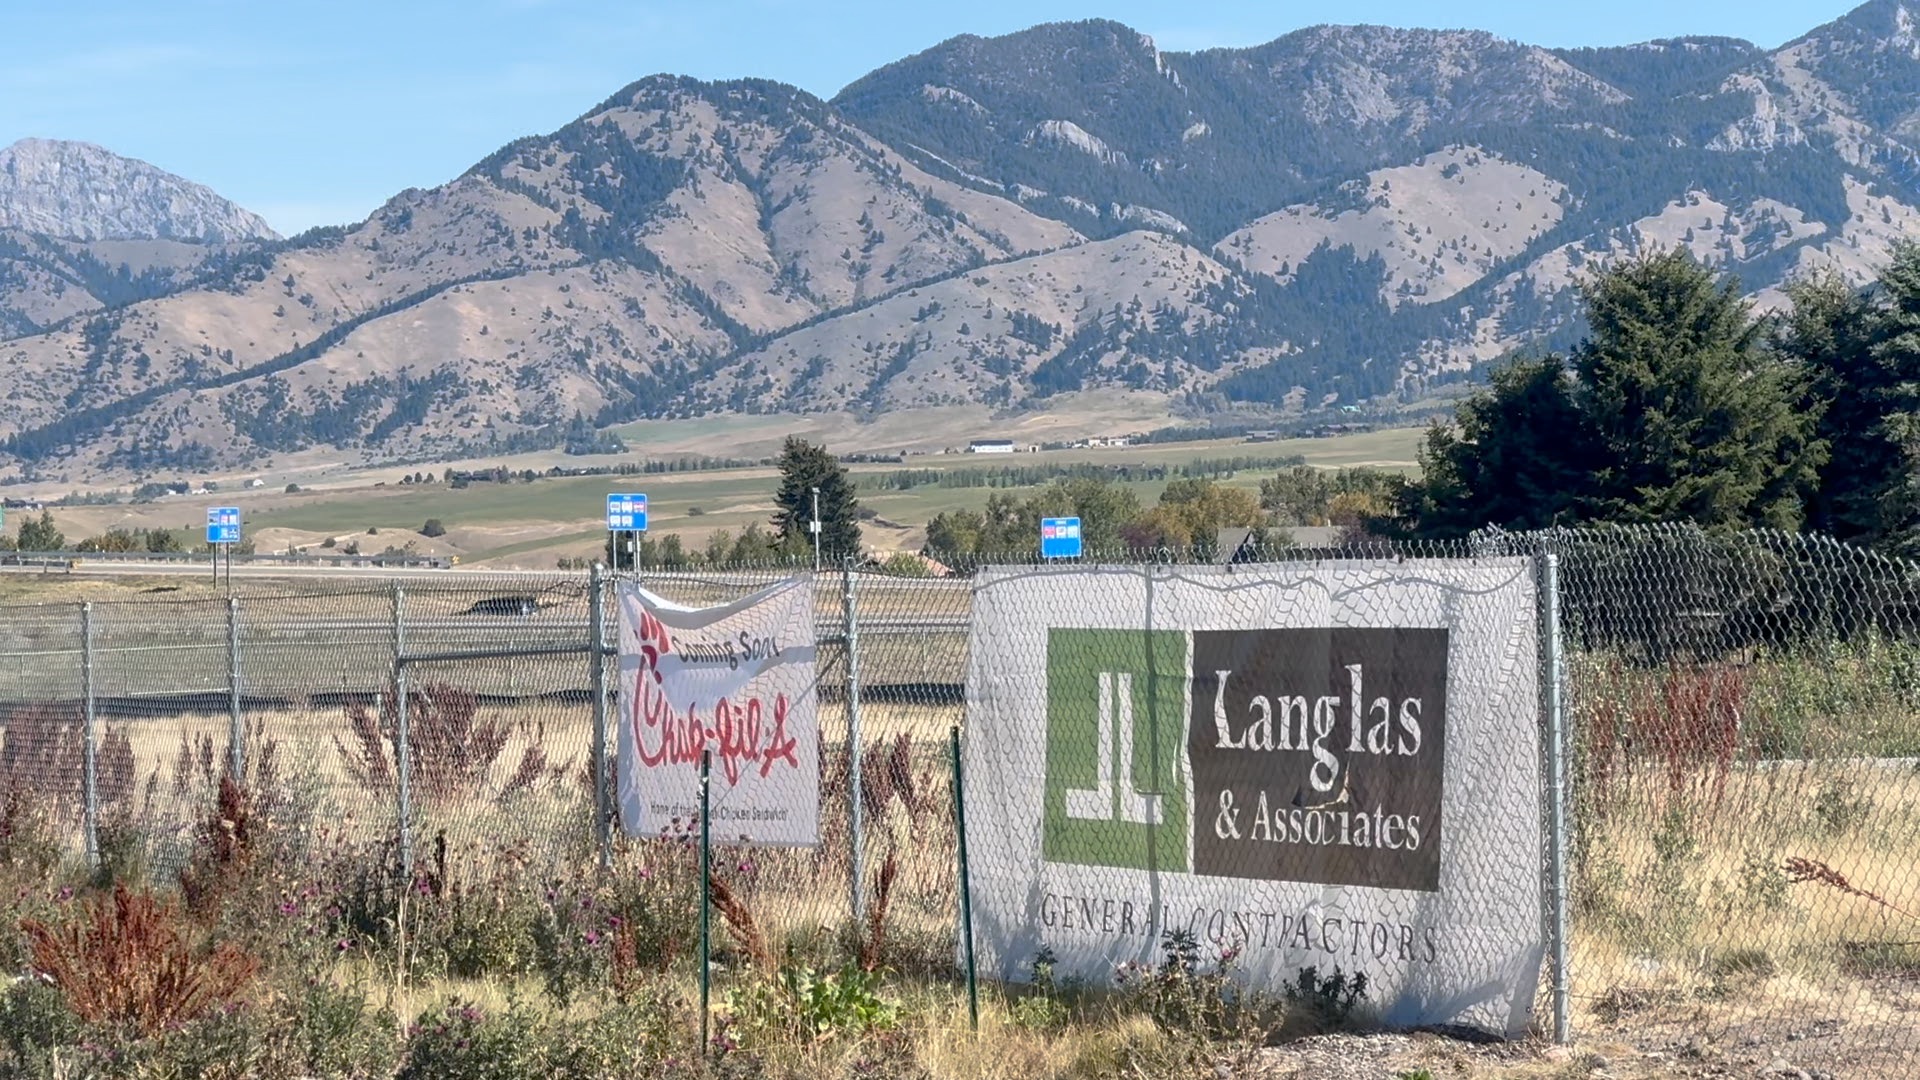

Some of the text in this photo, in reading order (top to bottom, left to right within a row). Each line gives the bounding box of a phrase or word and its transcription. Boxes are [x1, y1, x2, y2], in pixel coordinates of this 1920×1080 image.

[671, 636, 738, 671] Coming
[1214, 663, 1422, 792] Langlas
[1214, 789, 1421, 851] & Associates
[1041, 892, 1436, 964] GENERAL CONTRACTORS
